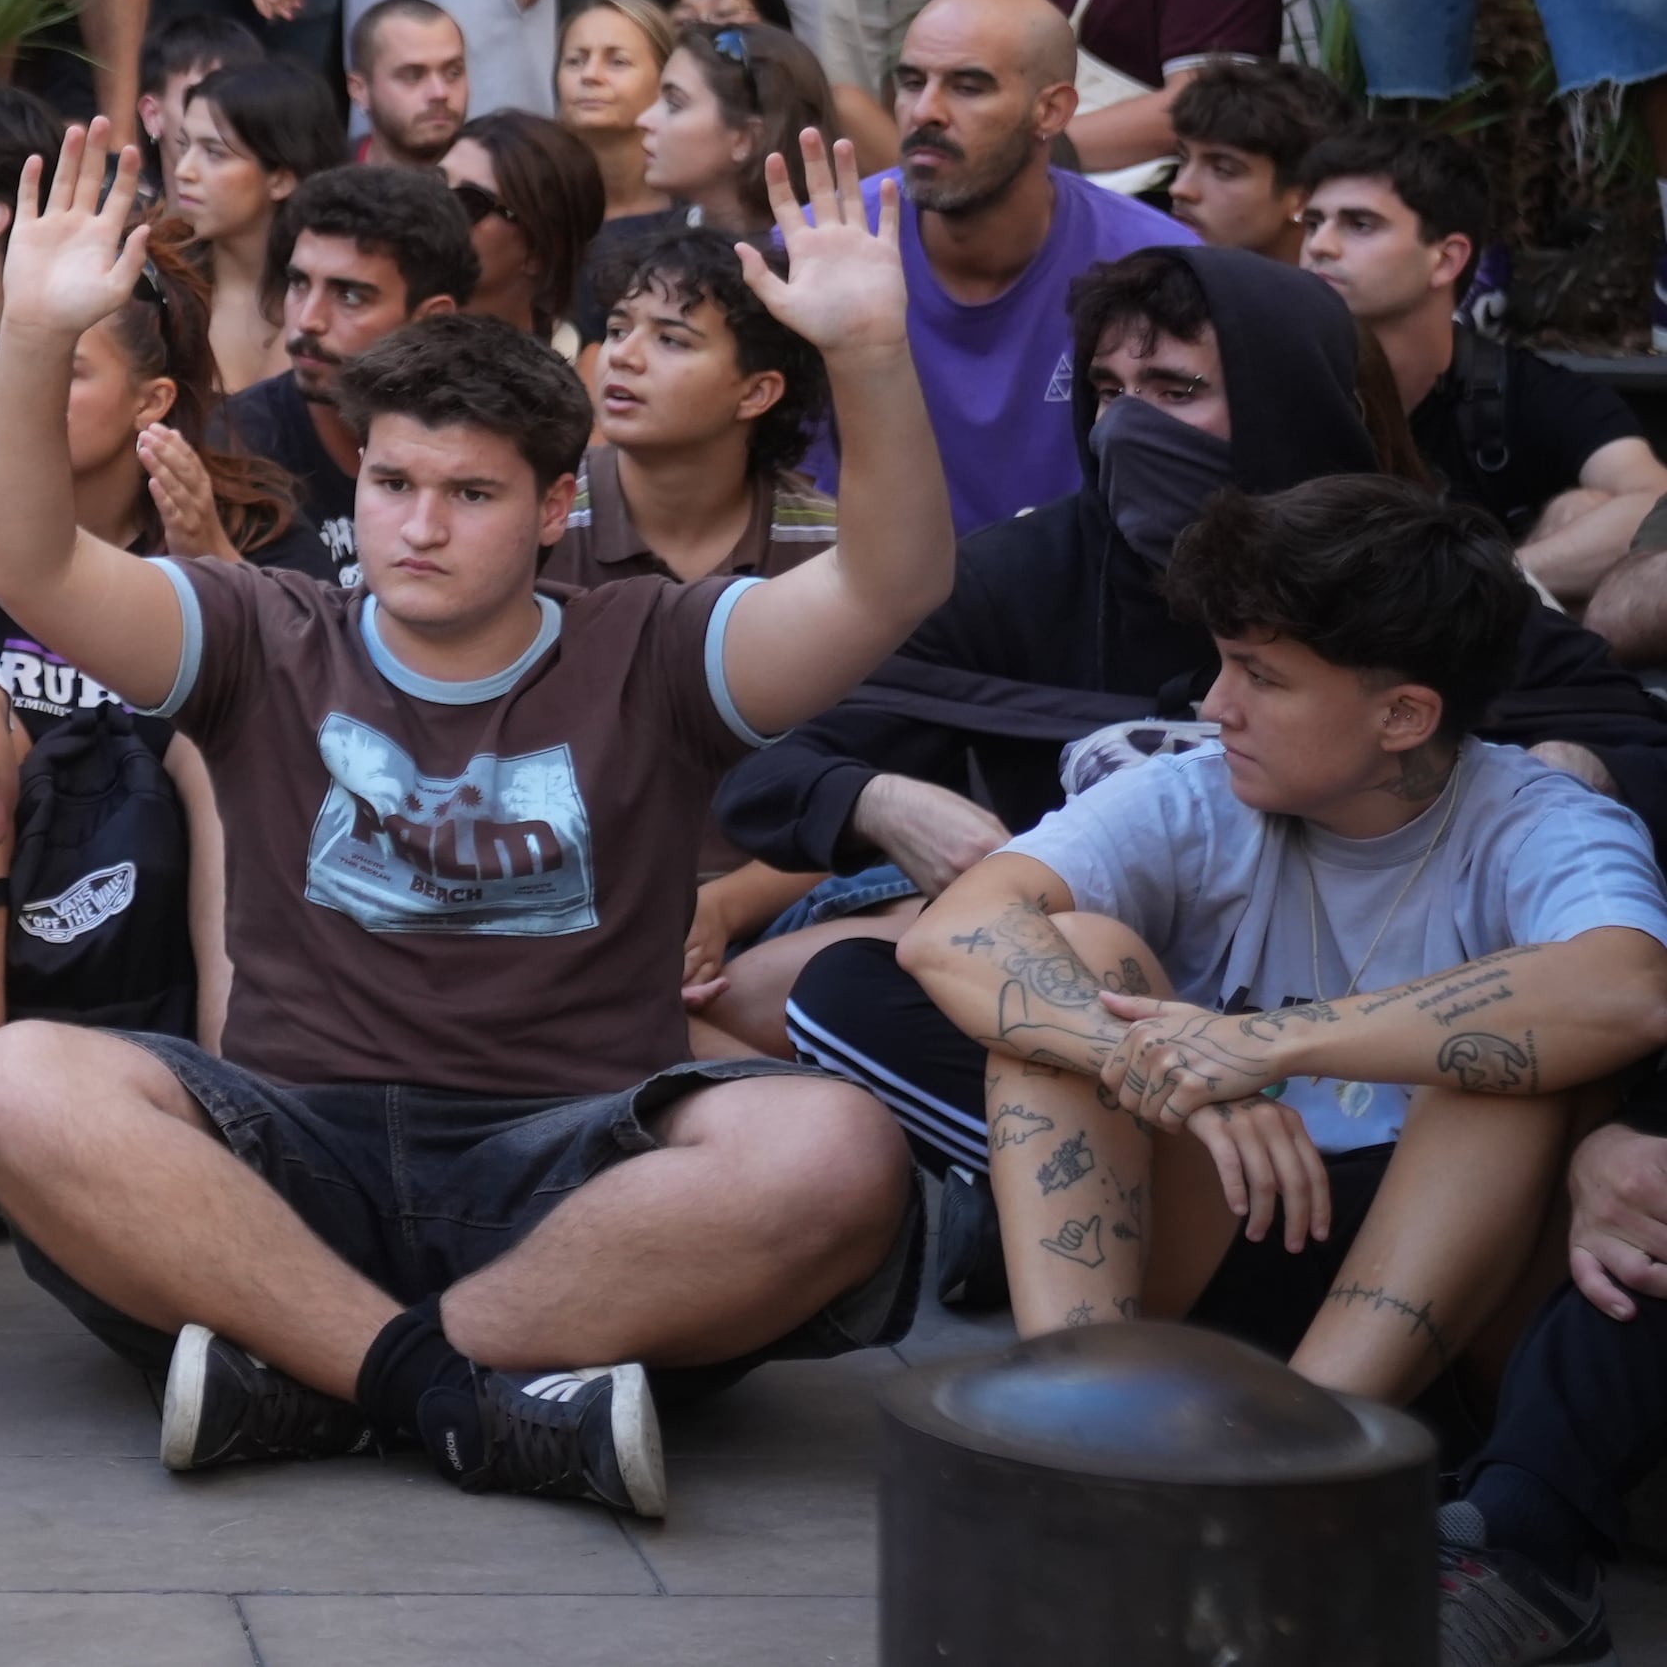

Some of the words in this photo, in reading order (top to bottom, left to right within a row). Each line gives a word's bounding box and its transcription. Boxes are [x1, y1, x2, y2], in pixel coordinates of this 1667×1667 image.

[49, 883, 95, 917] VANS
[409, 874, 483, 903] BEACH
[59, 900, 98, 929] THE
